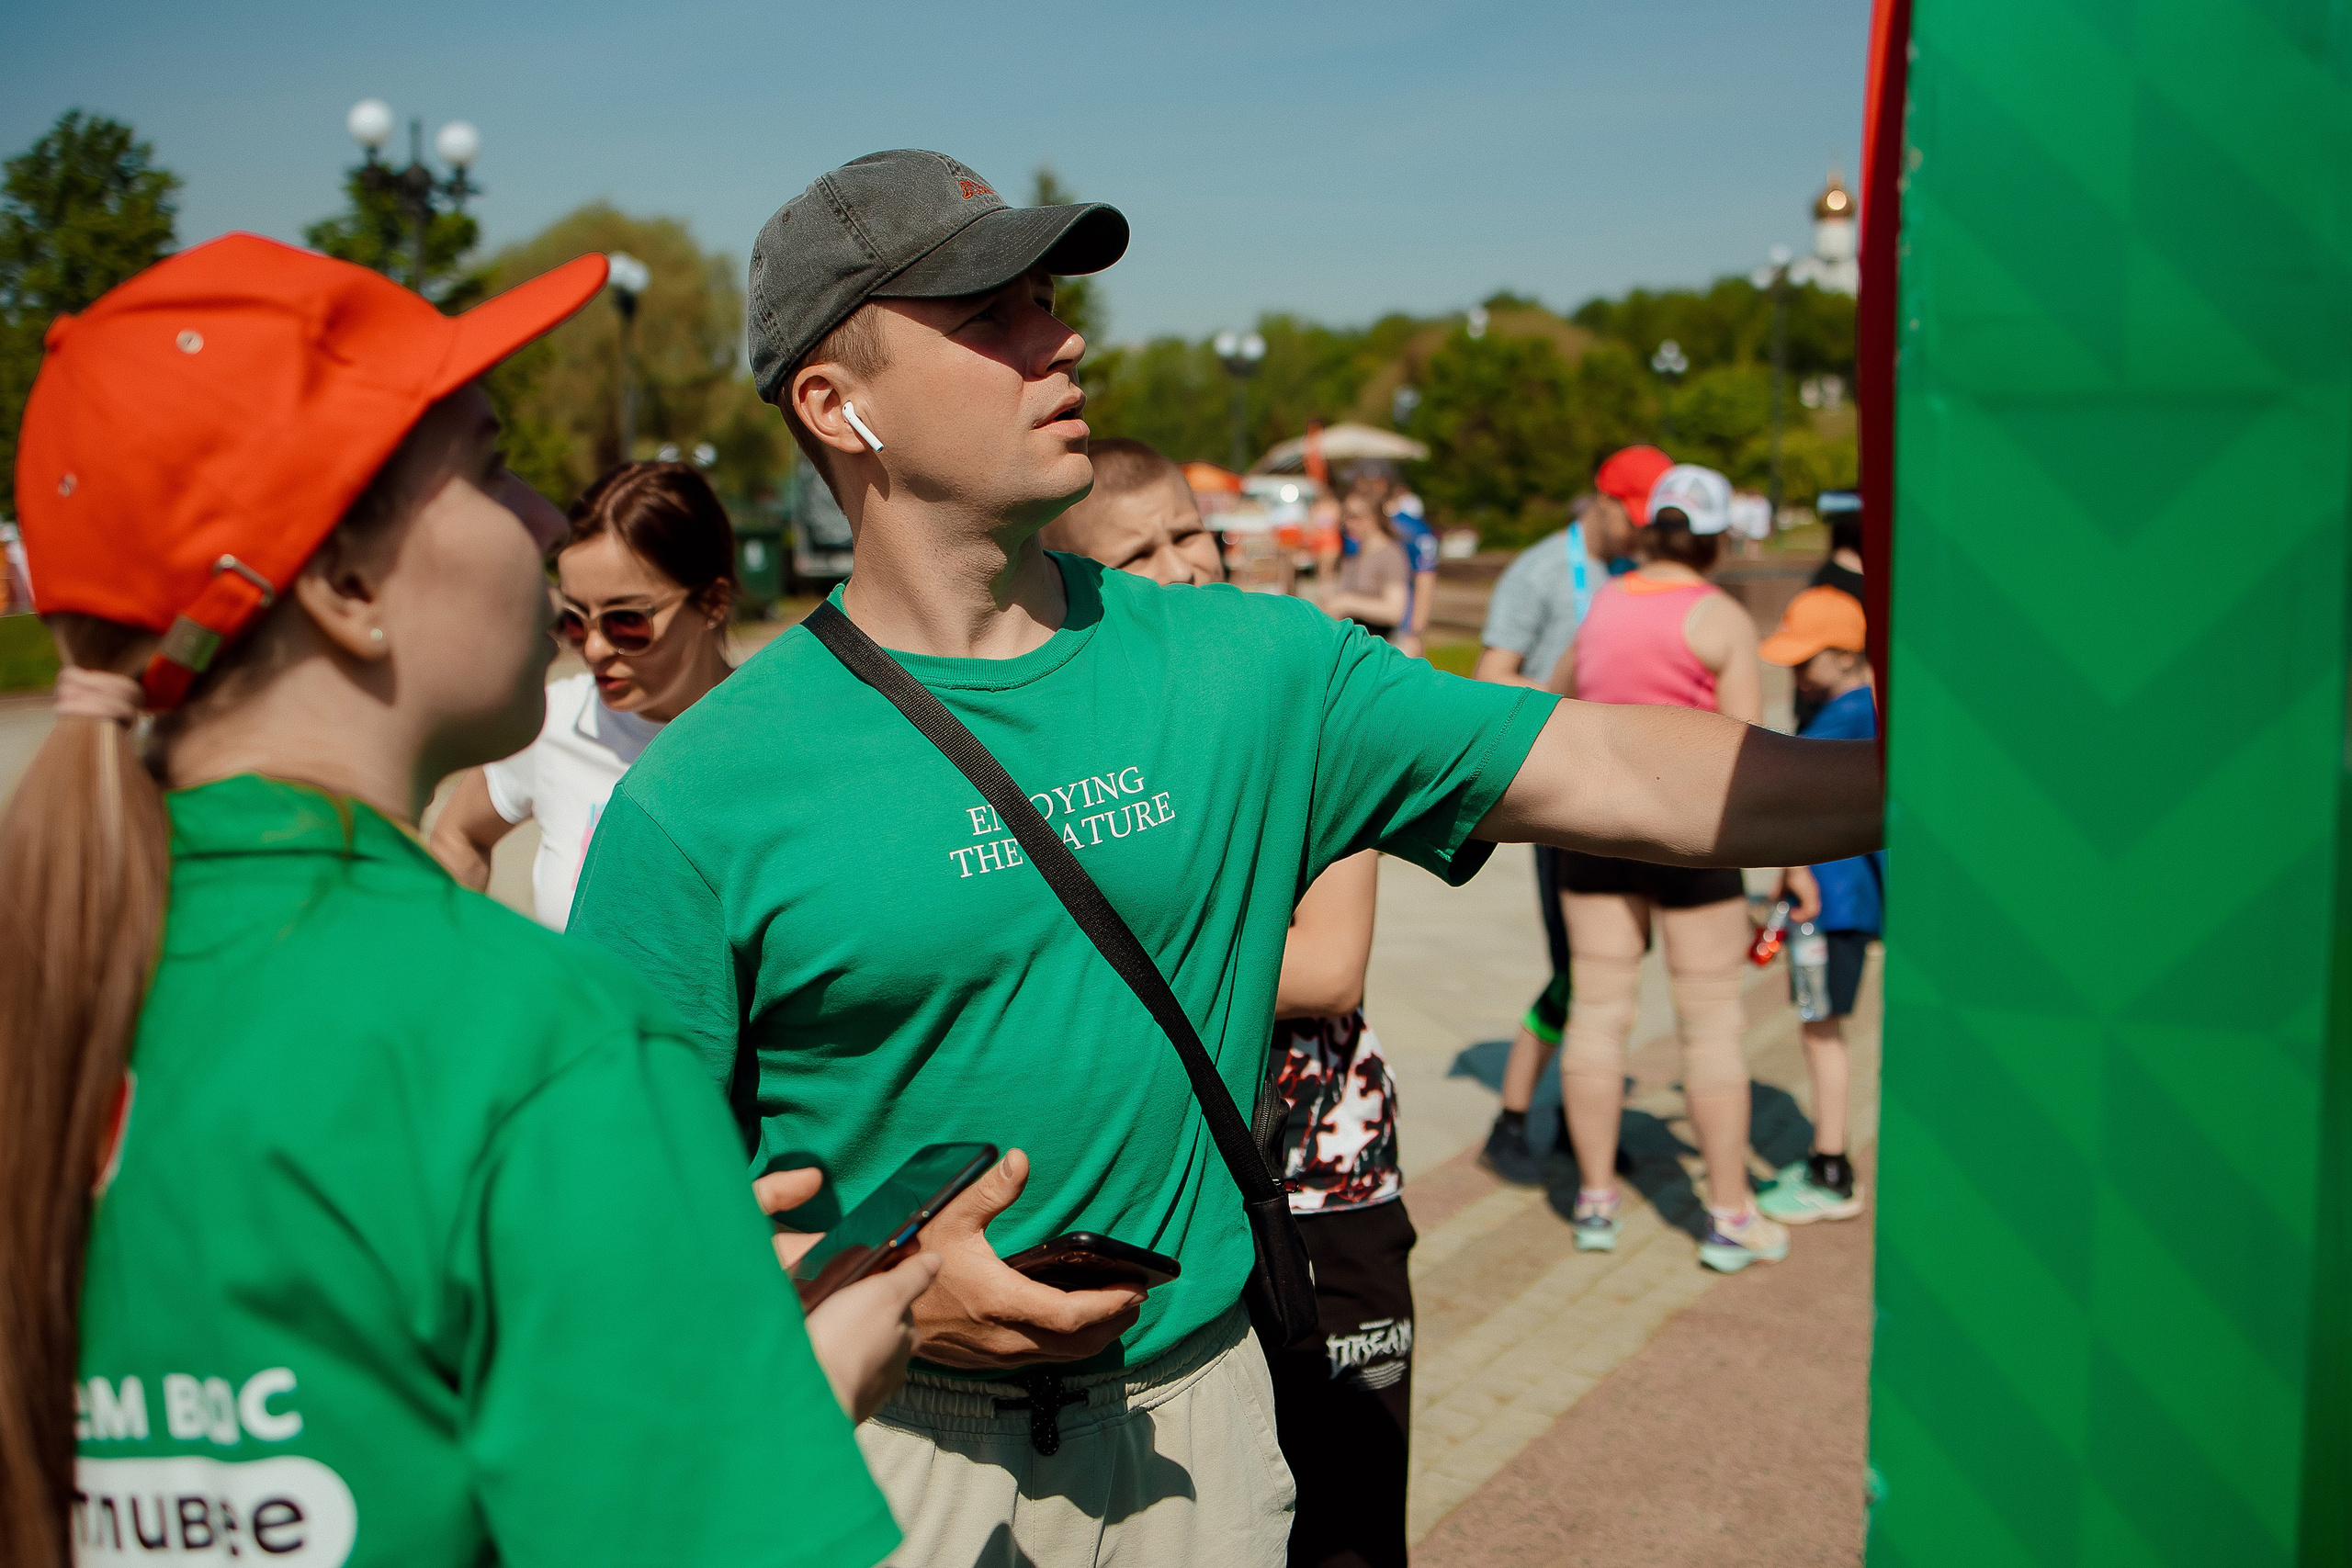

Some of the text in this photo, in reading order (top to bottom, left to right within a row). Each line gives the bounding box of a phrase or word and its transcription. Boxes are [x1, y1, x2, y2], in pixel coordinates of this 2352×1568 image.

[949, 791, 1176, 878] THE ATURE
[966, 766, 1145, 836] EOYING
